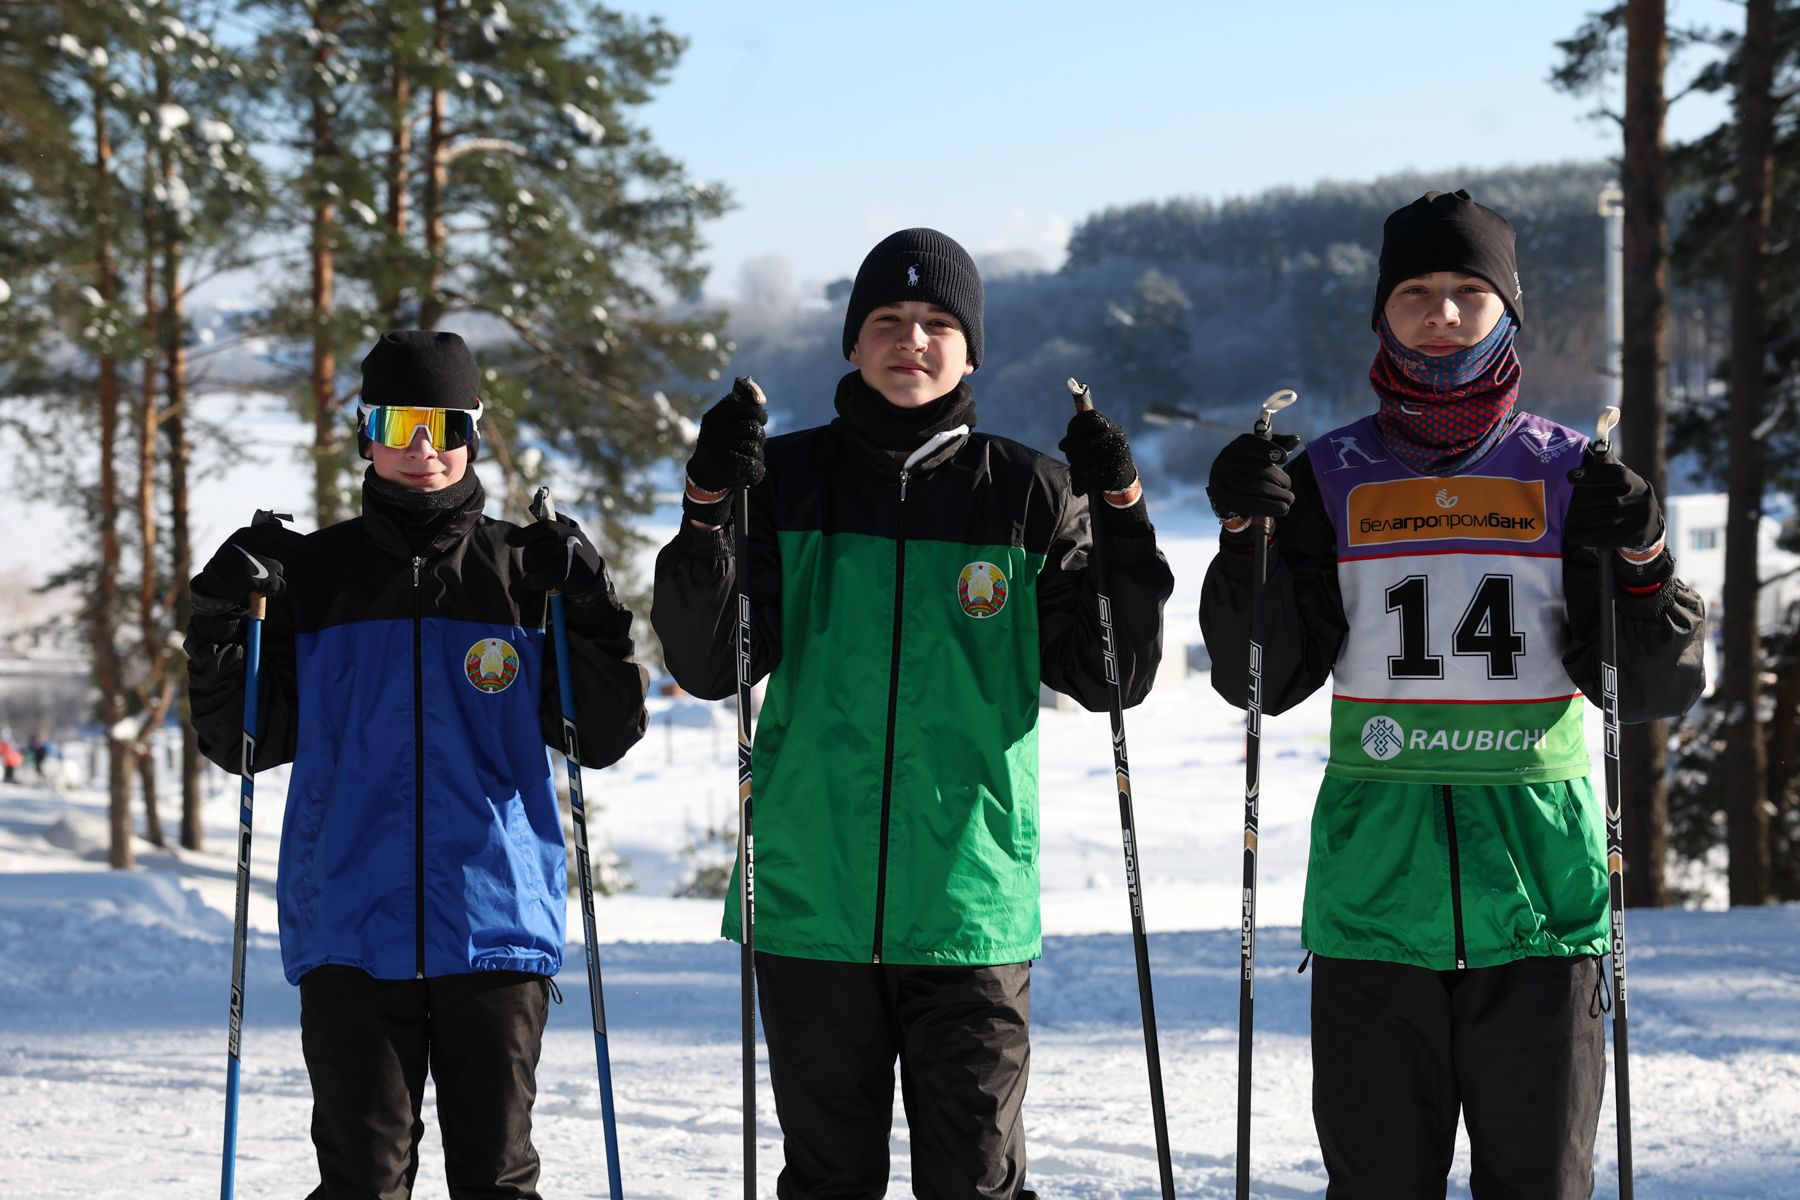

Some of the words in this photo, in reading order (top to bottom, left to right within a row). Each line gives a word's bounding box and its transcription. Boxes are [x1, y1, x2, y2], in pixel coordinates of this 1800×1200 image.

[1360, 512, 1537, 533] белагропромбанк
[1099, 595, 1117, 684] STC
[1385, 573, 1526, 680] 14
[1248, 642, 1261, 736] STC
[1603, 663, 1618, 759] STC
[1409, 728, 1548, 751] RAUBICHI
[746, 835, 755, 902] SPORT
[1122, 828, 1138, 895] SPORT
[1242, 887, 1252, 958] SPORT
[1612, 910, 1625, 979] SPORT
[229, 988, 241, 1056] CYBER
